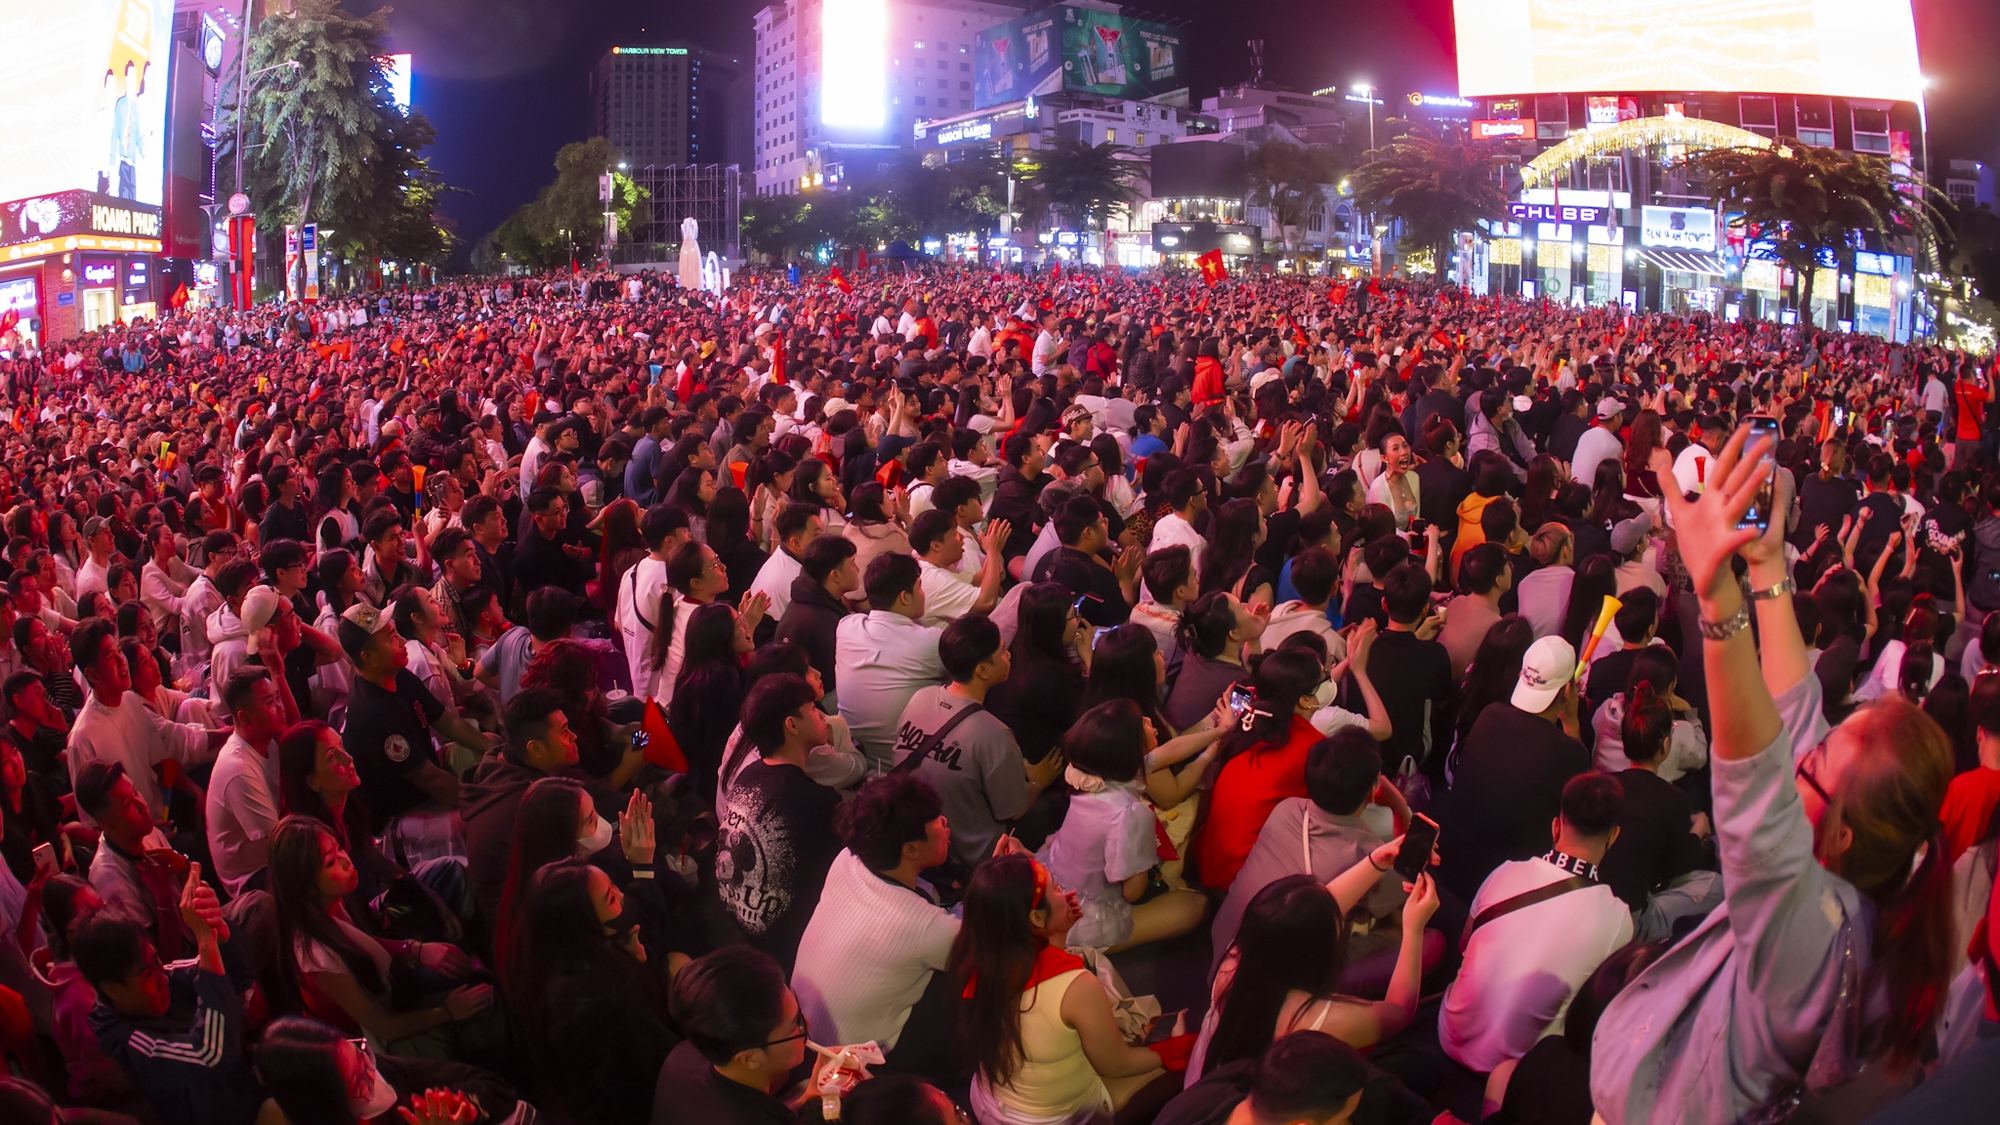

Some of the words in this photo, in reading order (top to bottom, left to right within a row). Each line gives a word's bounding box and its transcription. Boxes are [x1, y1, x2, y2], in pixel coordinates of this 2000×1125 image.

[620, 47, 649, 55] HARBOUR
[938, 130, 962, 144] SAIGON
[964, 124, 991, 138] GARDEN
[1482, 123, 1524, 135] Emirates
[93, 205, 131, 234] HOANG
[133, 211, 158, 236] PHUC
[1646, 227, 1661, 239] SUN
[1663, 229, 1682, 241] WAH
[1684, 231, 1712, 243] TOWER
